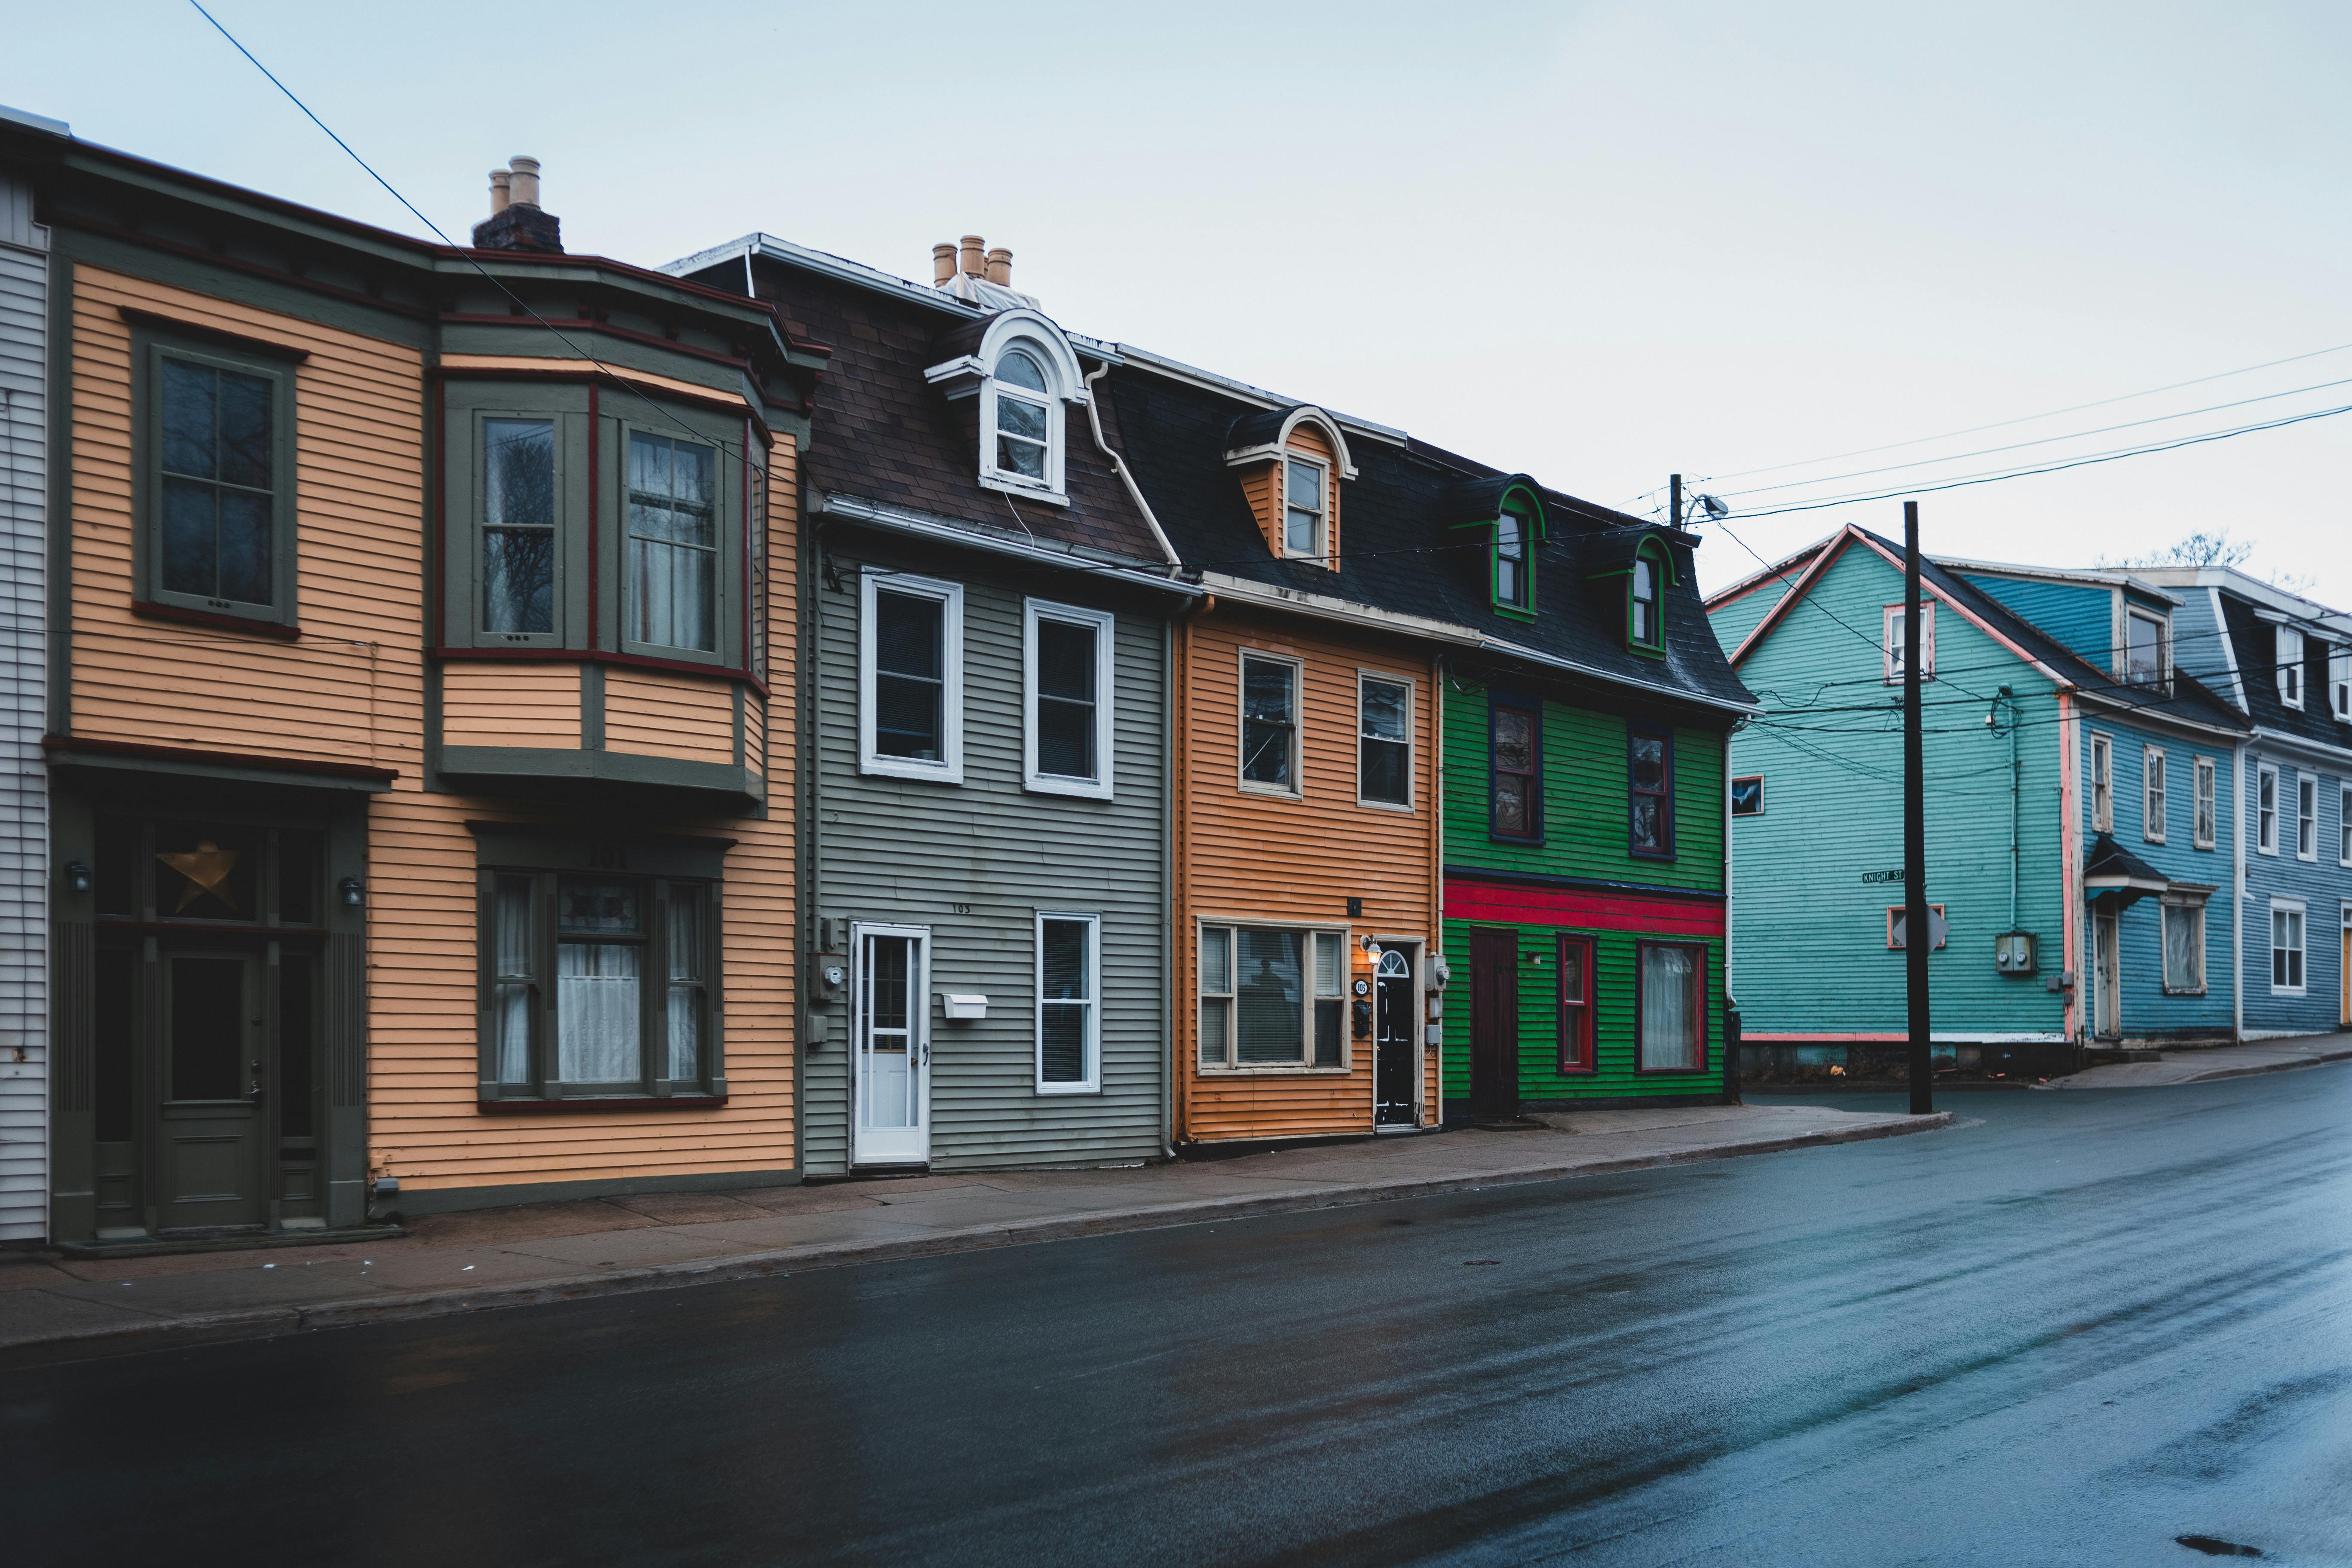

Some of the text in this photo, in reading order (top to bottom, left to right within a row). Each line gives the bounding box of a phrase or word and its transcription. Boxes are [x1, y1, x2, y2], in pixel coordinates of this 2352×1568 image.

[1864, 870, 1902, 882] KNIGHT ST
[953, 904, 970, 914] 103
